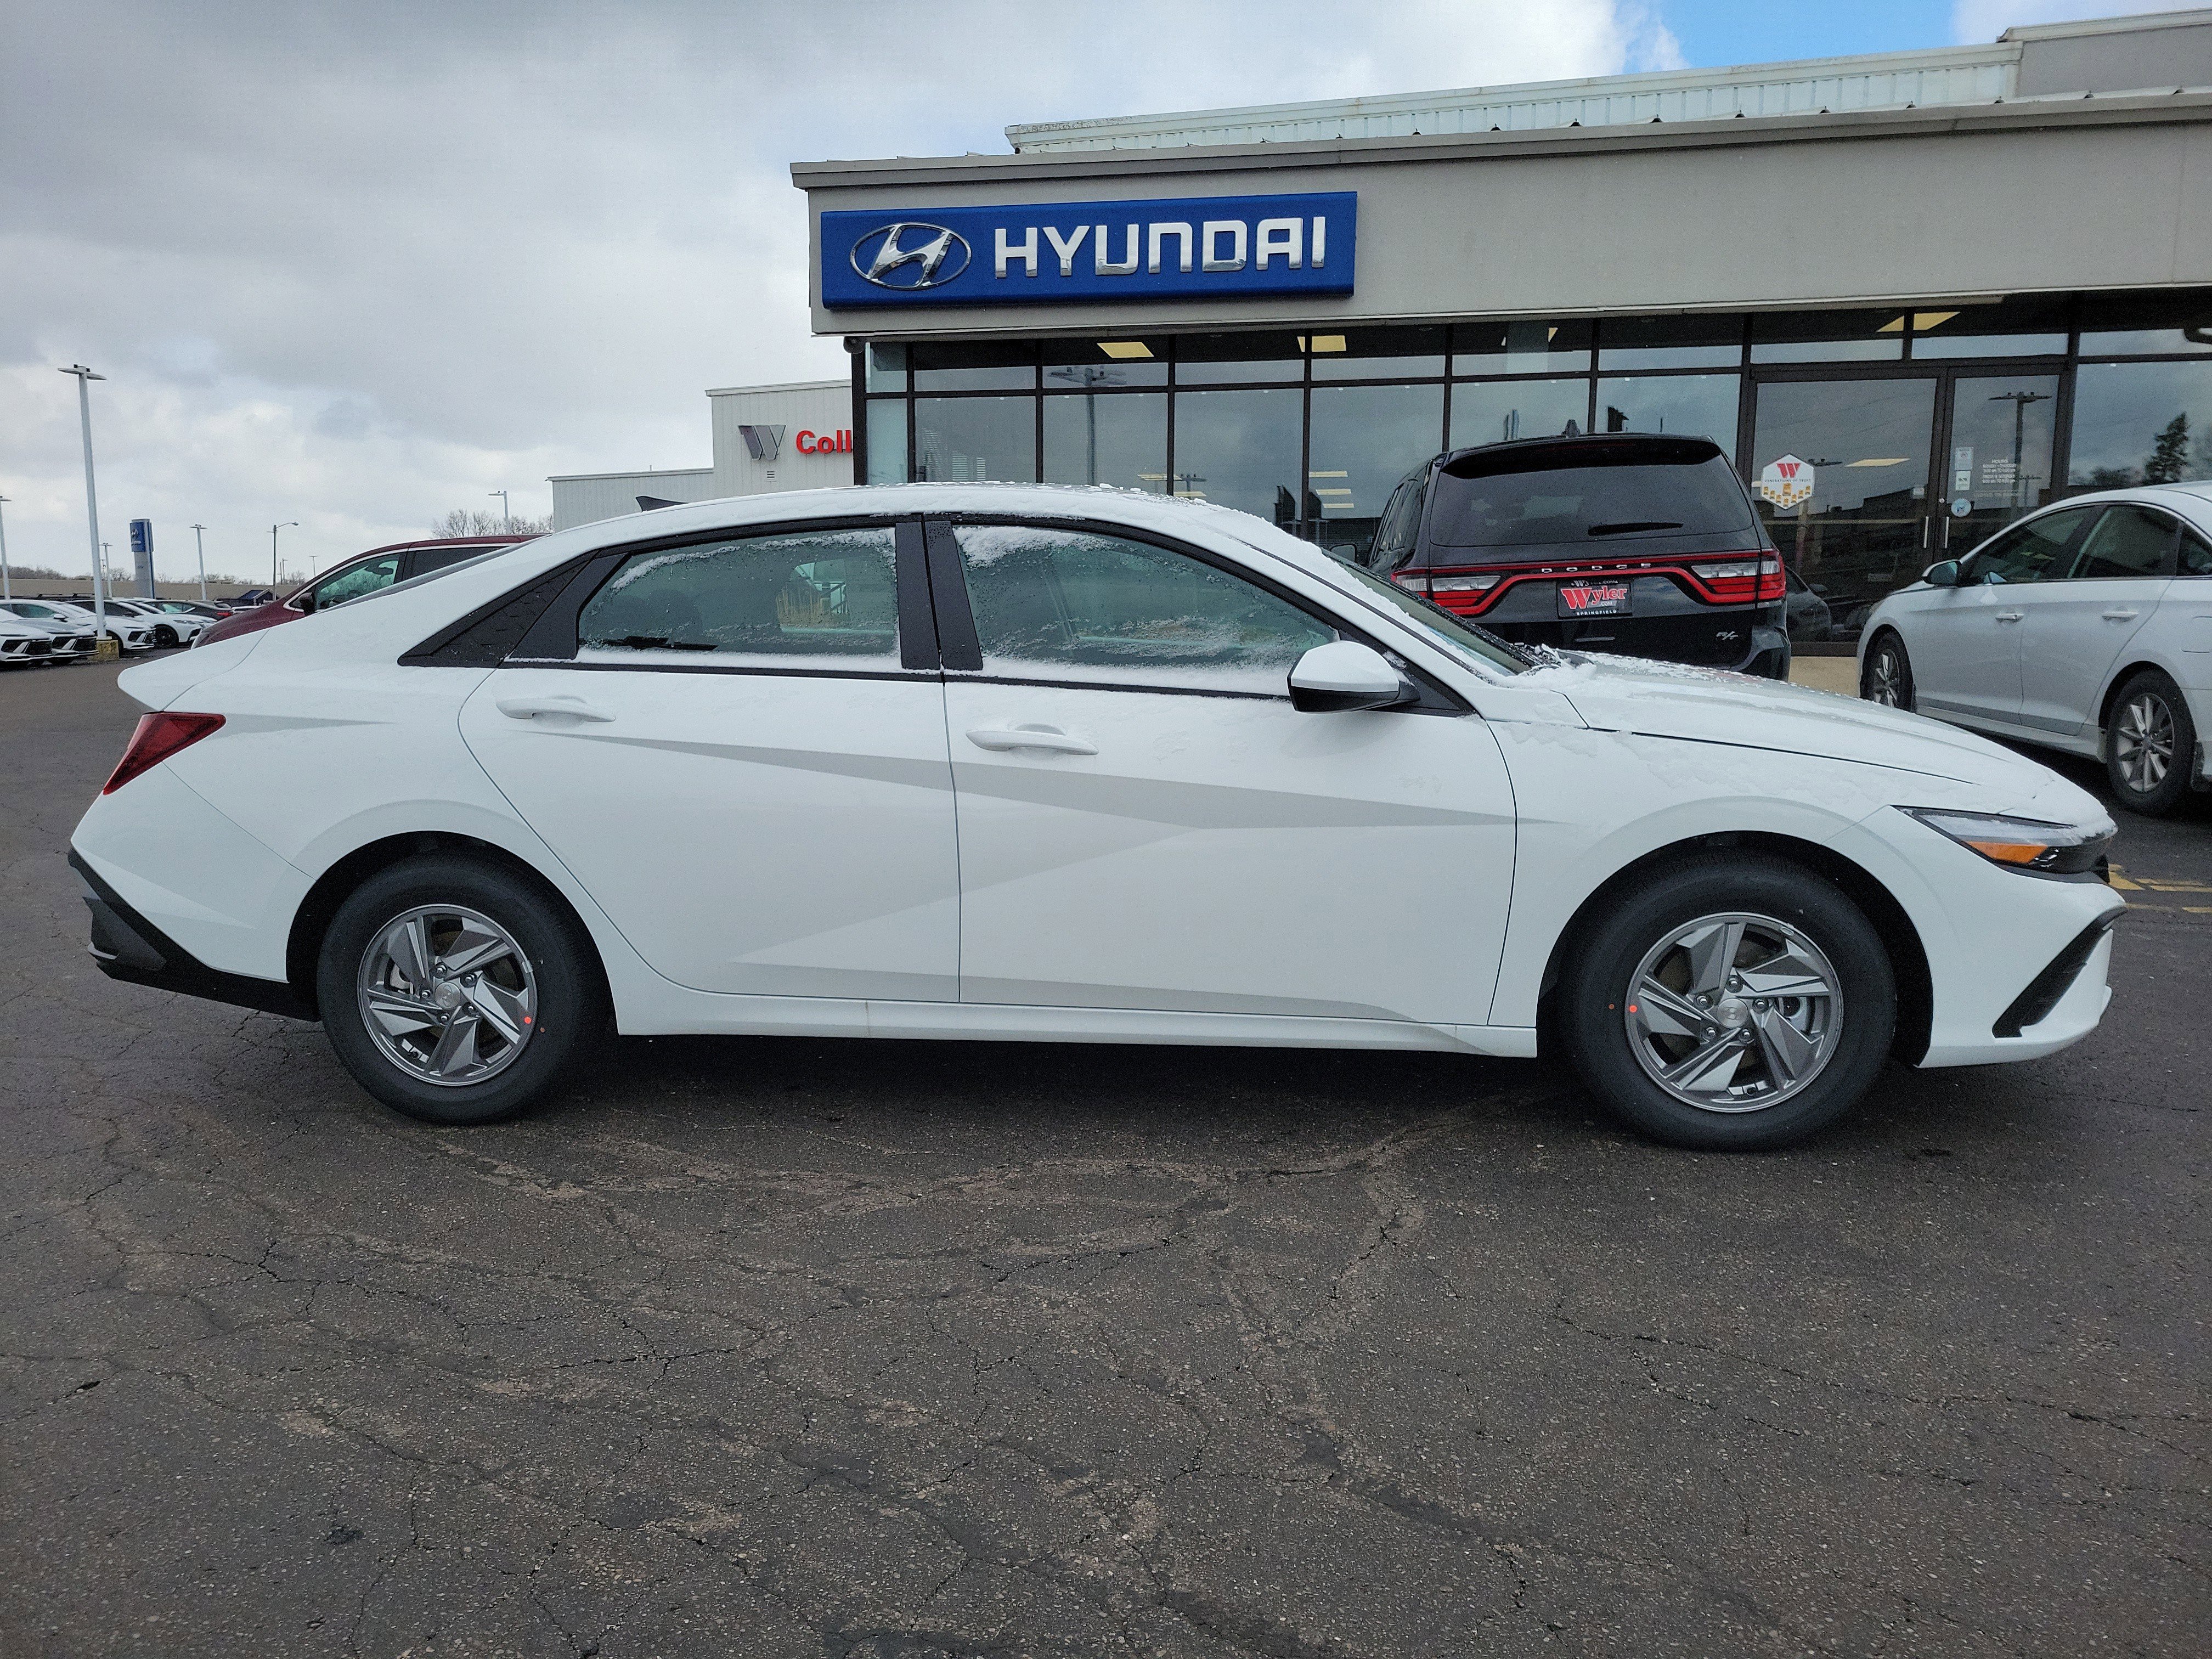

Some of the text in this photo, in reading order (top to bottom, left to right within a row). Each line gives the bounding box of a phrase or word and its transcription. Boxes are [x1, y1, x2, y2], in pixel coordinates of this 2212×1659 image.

[995, 216, 1326, 279] HYUNDAI
[796, 430, 852, 454] Coll
[1541, 562, 1651, 573] DODGE
[1560, 585, 1628, 610] Wyler
